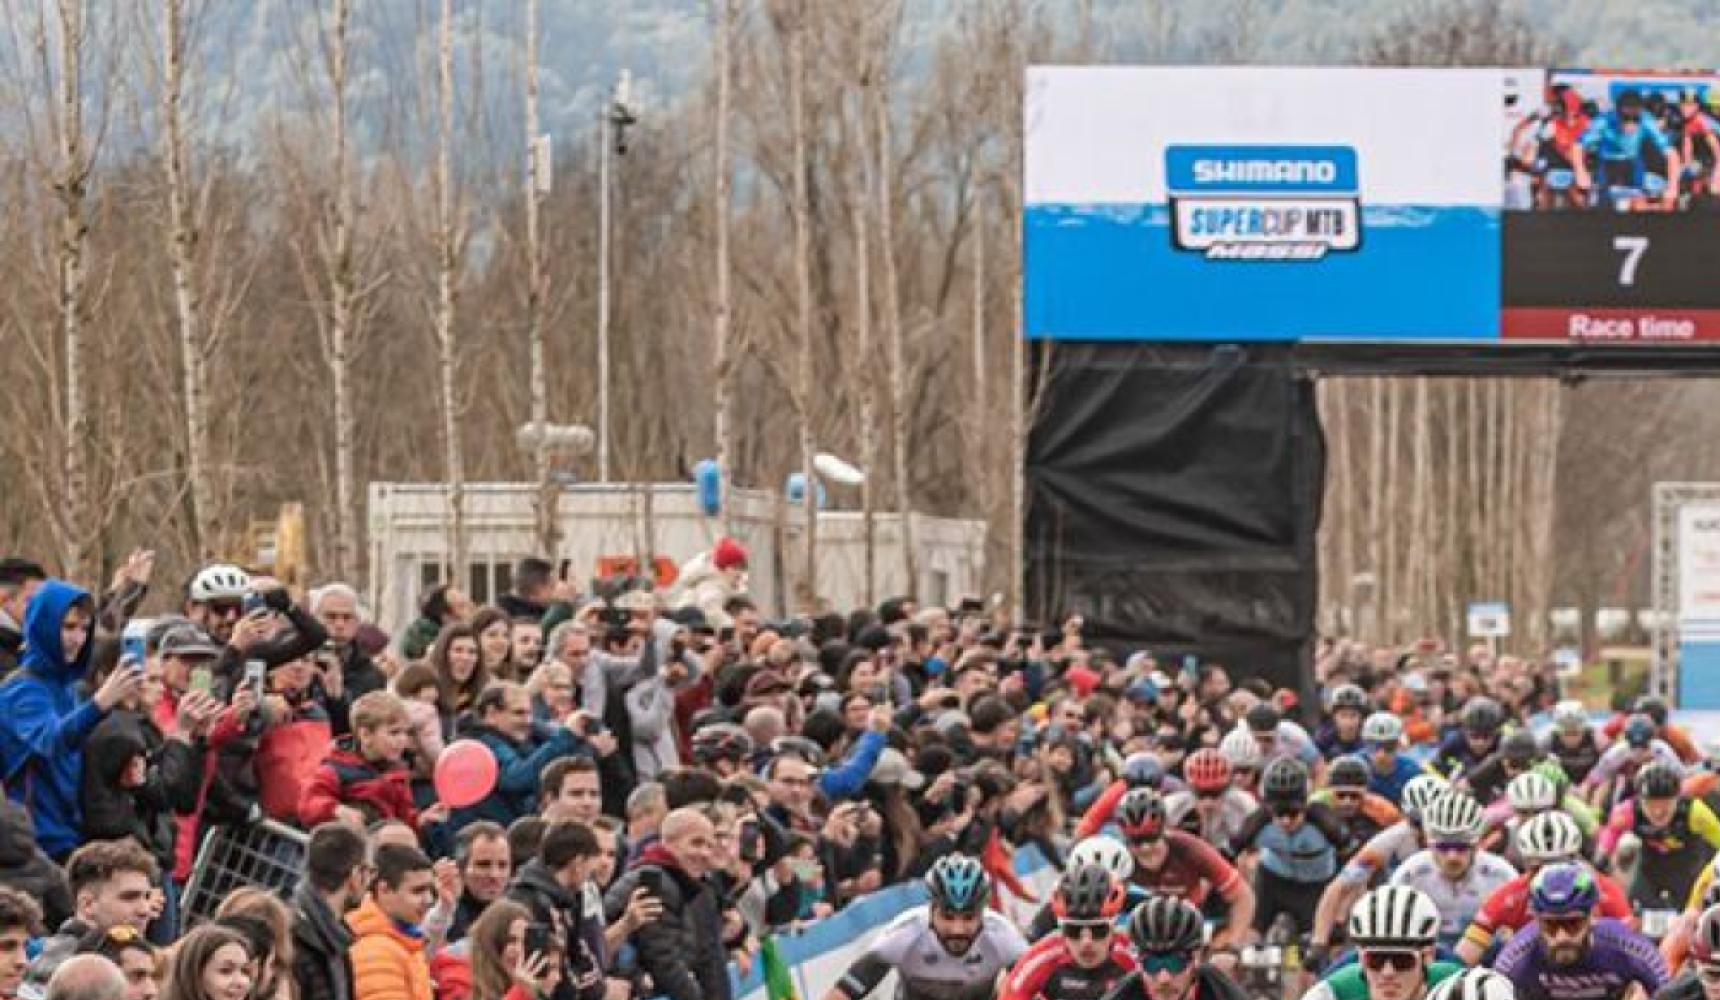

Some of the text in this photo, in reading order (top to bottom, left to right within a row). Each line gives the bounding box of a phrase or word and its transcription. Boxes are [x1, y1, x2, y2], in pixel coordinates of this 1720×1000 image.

[1192, 159, 1337, 184] SHIMANO
[1189, 206, 1344, 237] SUPERCUP MTB
[1612, 236, 1650, 286] 7
[1569, 313, 1694, 338] Race time
